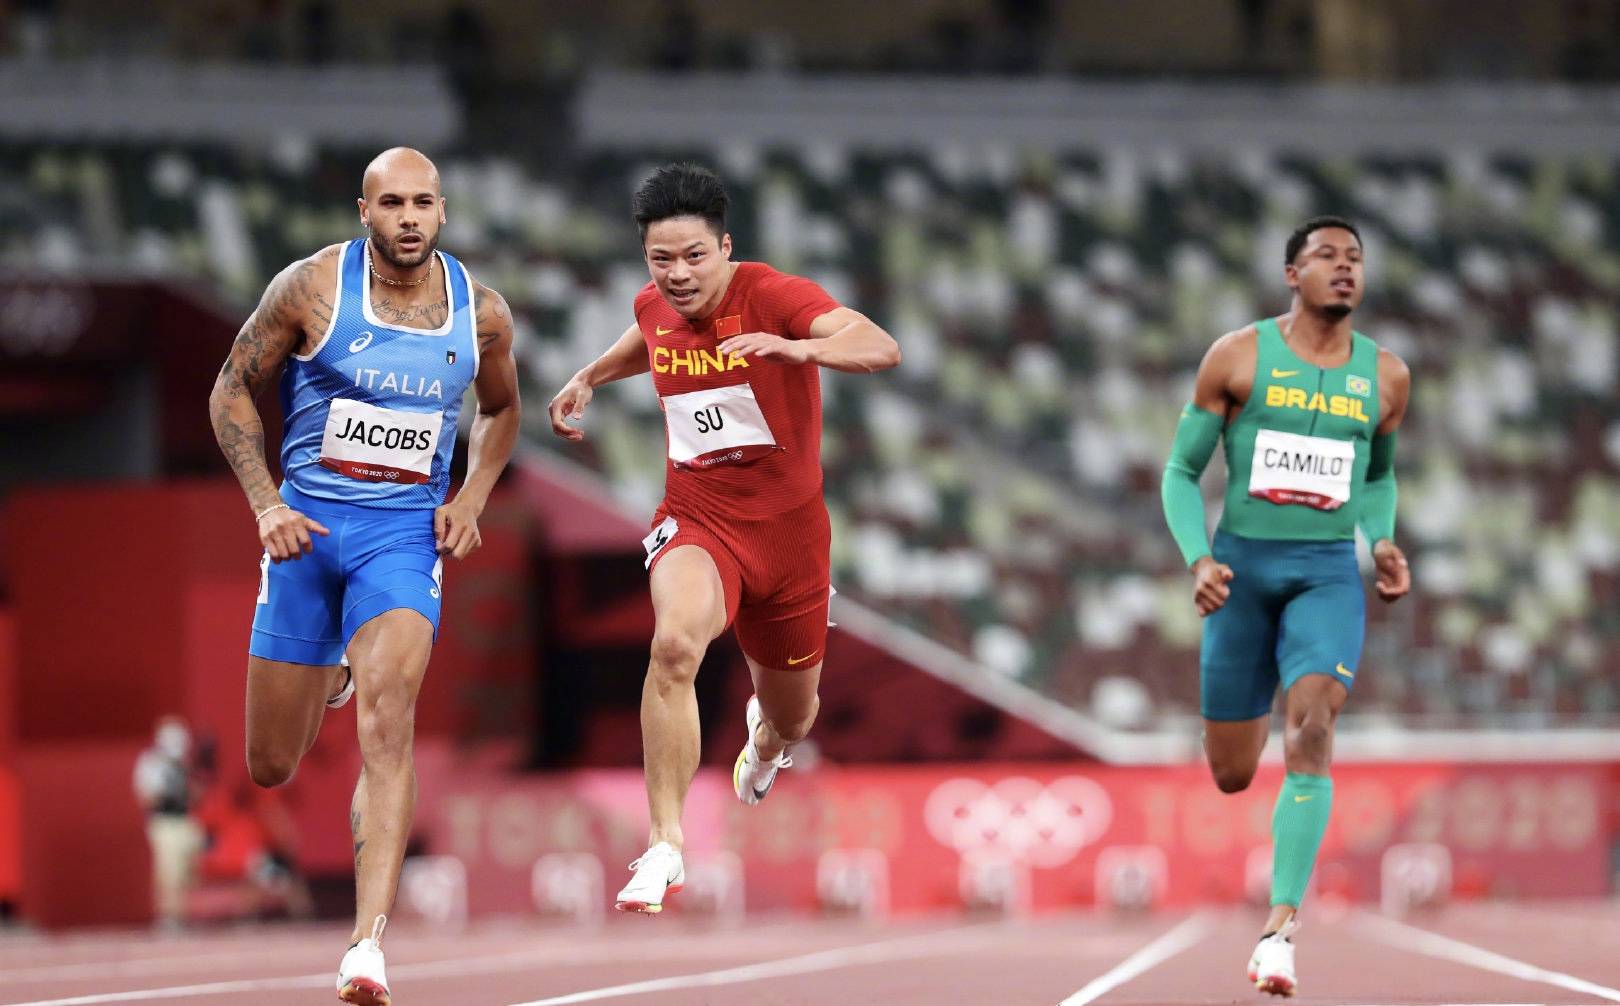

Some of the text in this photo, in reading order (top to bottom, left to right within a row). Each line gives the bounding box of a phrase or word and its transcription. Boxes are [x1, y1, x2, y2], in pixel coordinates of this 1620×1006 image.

[653, 346, 750, 376] CHINA
[355, 368, 442, 399] ITALIA
[1266, 385, 1370, 423] BRASIL
[335, 417, 432, 451] JACOBS
[694, 406, 724, 433] SU
[351, 466, 369, 475] TOKYO
[1264, 448, 1344, 476] CAMILO
